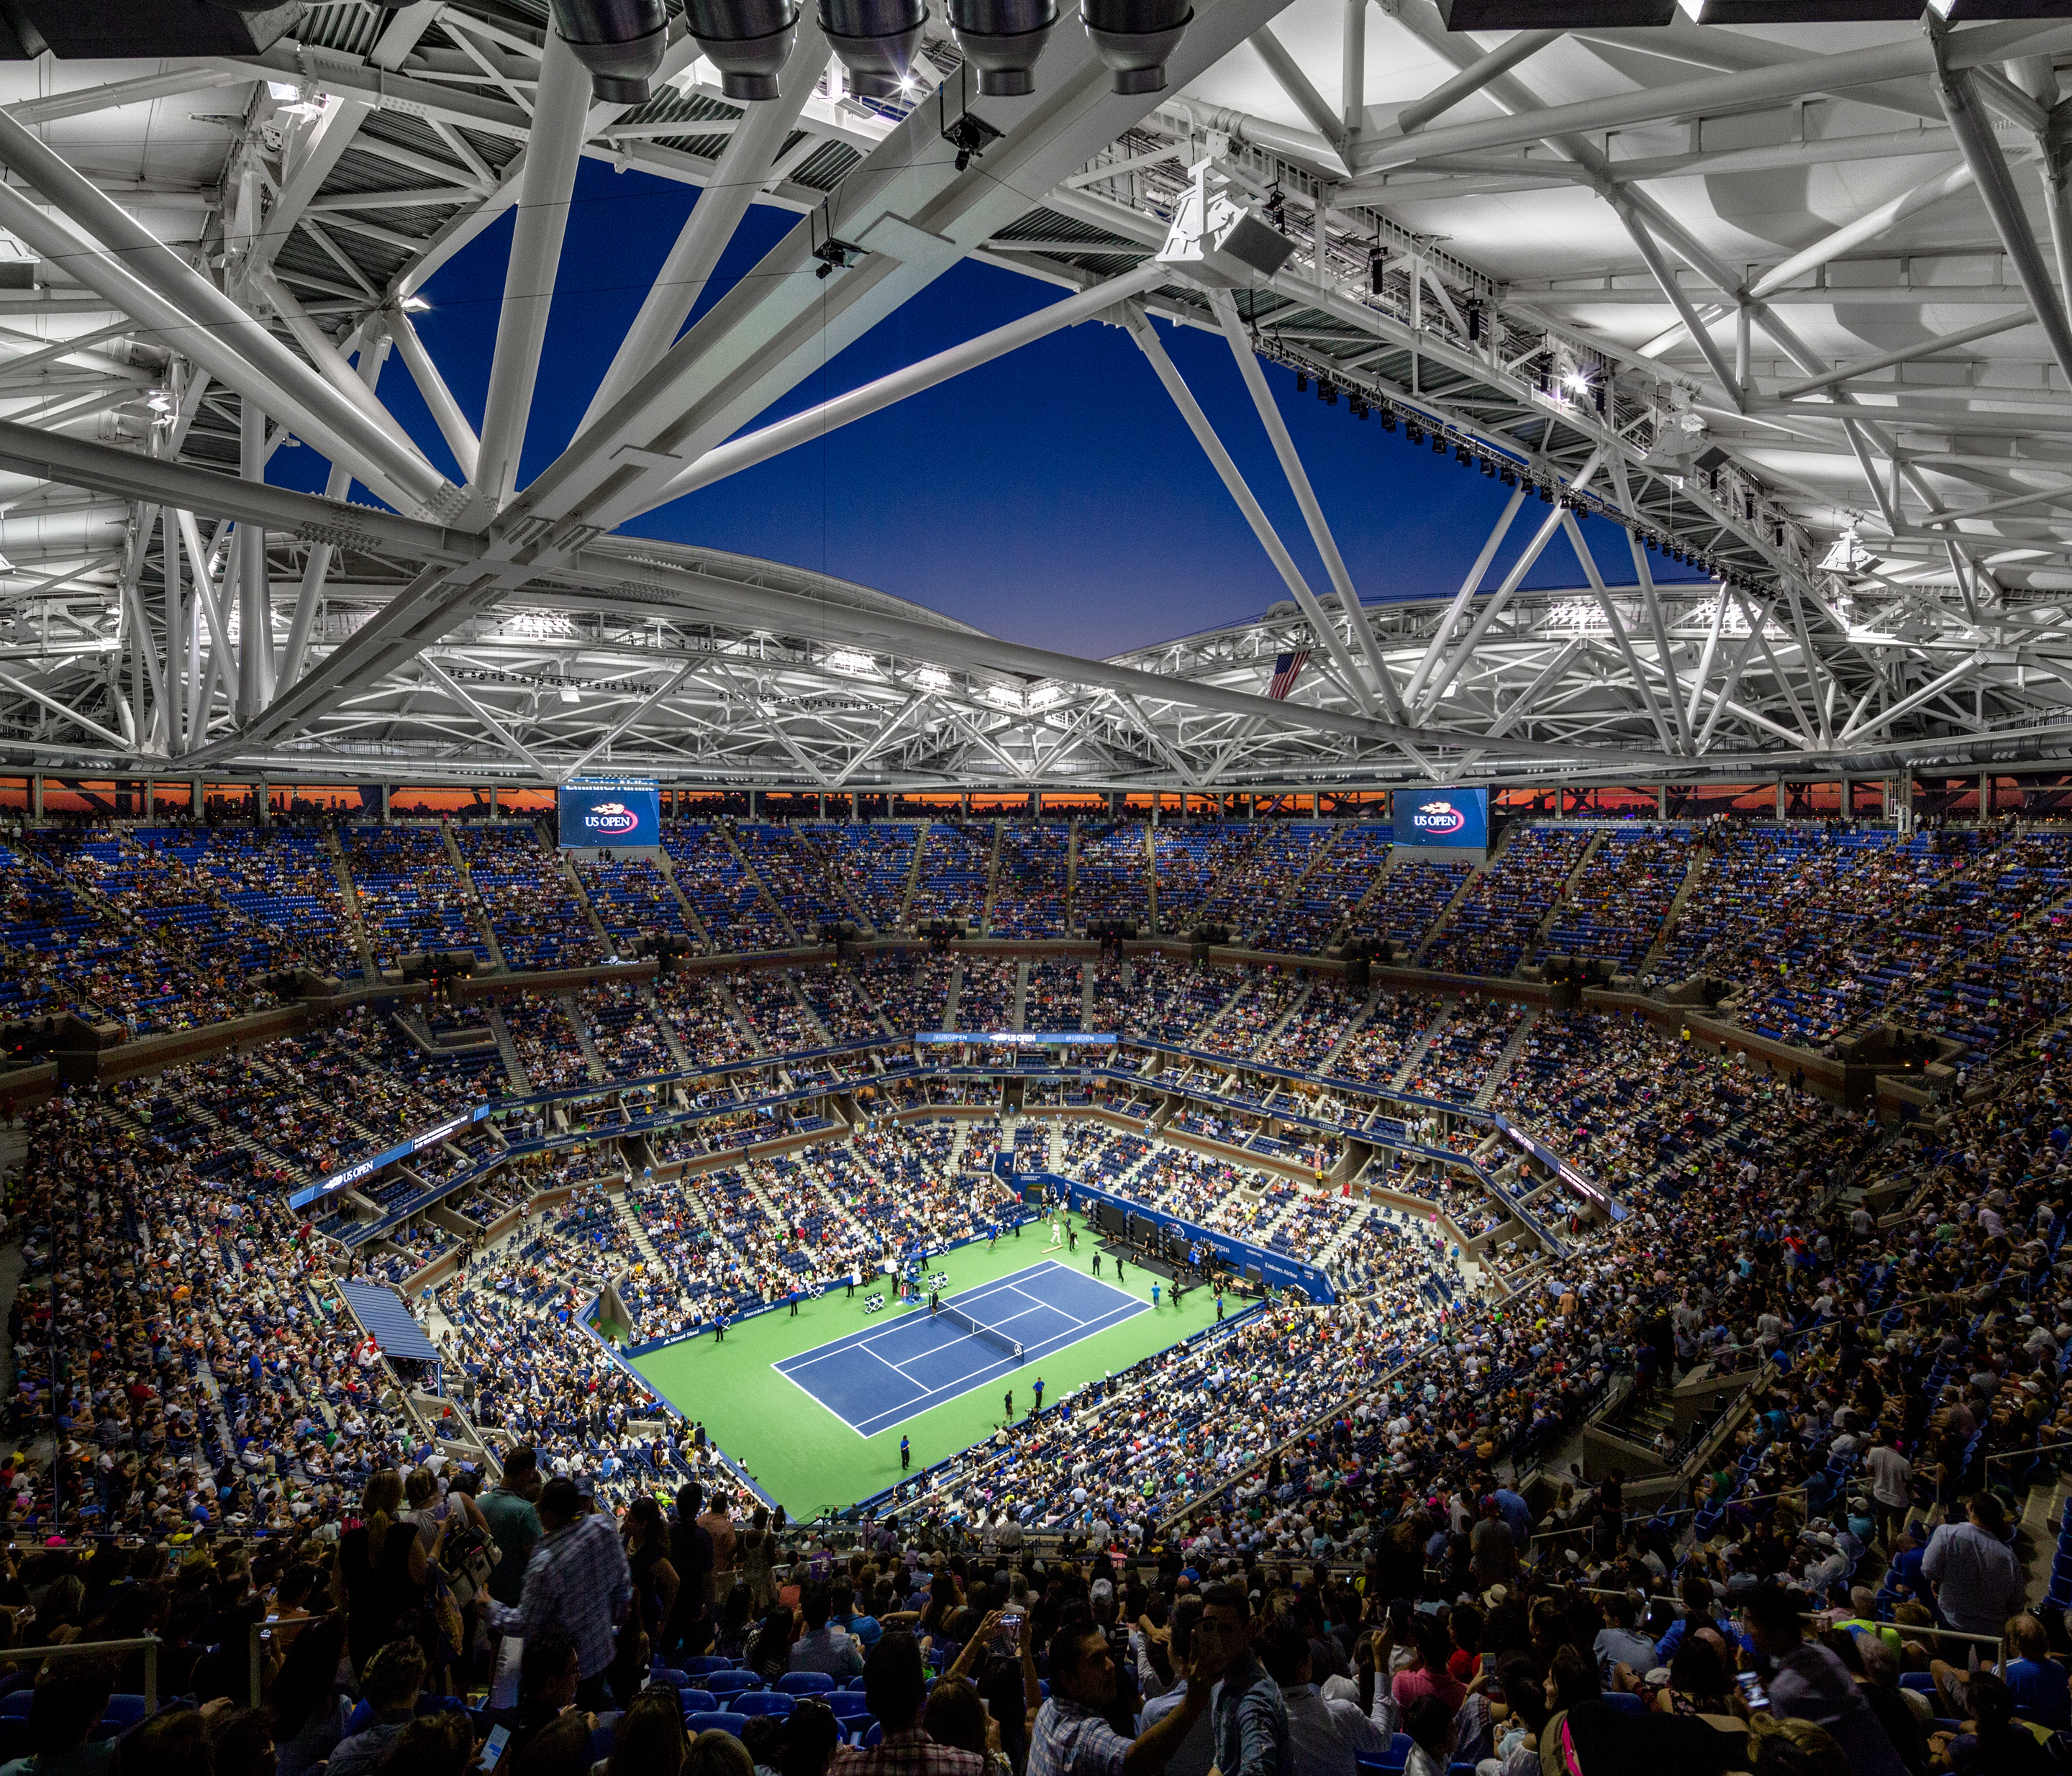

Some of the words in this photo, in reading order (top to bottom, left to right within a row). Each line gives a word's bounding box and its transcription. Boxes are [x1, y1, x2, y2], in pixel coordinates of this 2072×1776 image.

[585, 816, 599, 826] US
[600, 816, 630, 826] OPEN
[1414, 816, 1427, 826] US
[1427, 816, 1457, 826] OPEN
[653, 1118, 674, 1126] CHASE
[1319, 1123, 1339, 1131] CITIZEN
[545, 1138, 576, 1148] ticketmaster
[1524, 1137, 1535, 1152] OPEN
[343, 1170, 353, 1182] US
[353, 1160, 373, 1178] OPEN
[1246, 1263, 1261, 1272] CITIZEN
[1265, 1262, 1283, 1273] Emirates
[1283, 1269, 1298, 1279] Airline
[744, 1305, 774, 1318] Mercedes-Benz
[671, 1334, 686, 1343] Mount
[687, 1329, 699, 1337] Sinai
